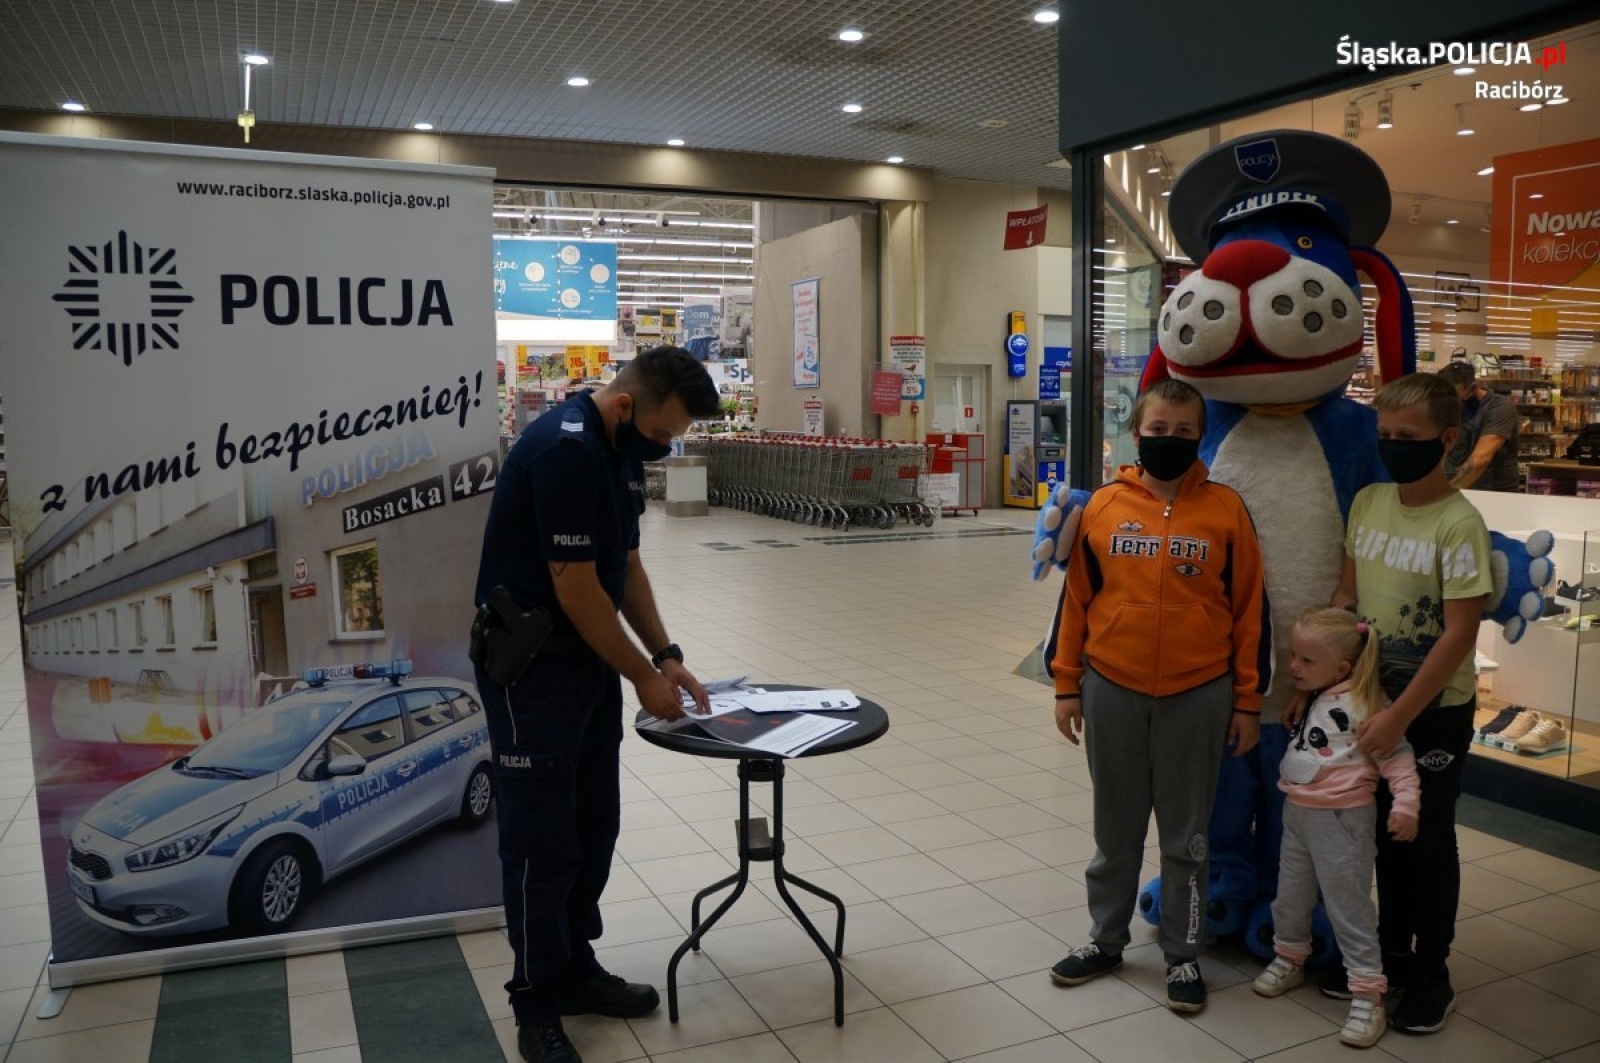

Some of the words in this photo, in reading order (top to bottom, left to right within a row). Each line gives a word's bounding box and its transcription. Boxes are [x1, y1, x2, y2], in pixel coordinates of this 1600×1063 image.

[177, 180, 450, 209] www.raciborz.slaska.policja.gov.pl
[1523, 236, 1600, 265] kolekc
[219, 273, 454, 327] POLICJA
[40, 483, 67, 514] z
[84, 441, 201, 503] nami
[214, 370, 484, 473] bezpieczniej!
[302, 429, 437, 507] POLICJA
[343, 485, 443, 532] Bosacka
[453, 455, 496, 497] 42
[553, 534, 592, 547] POLICJA
[337, 772, 390, 811] POLICJA
